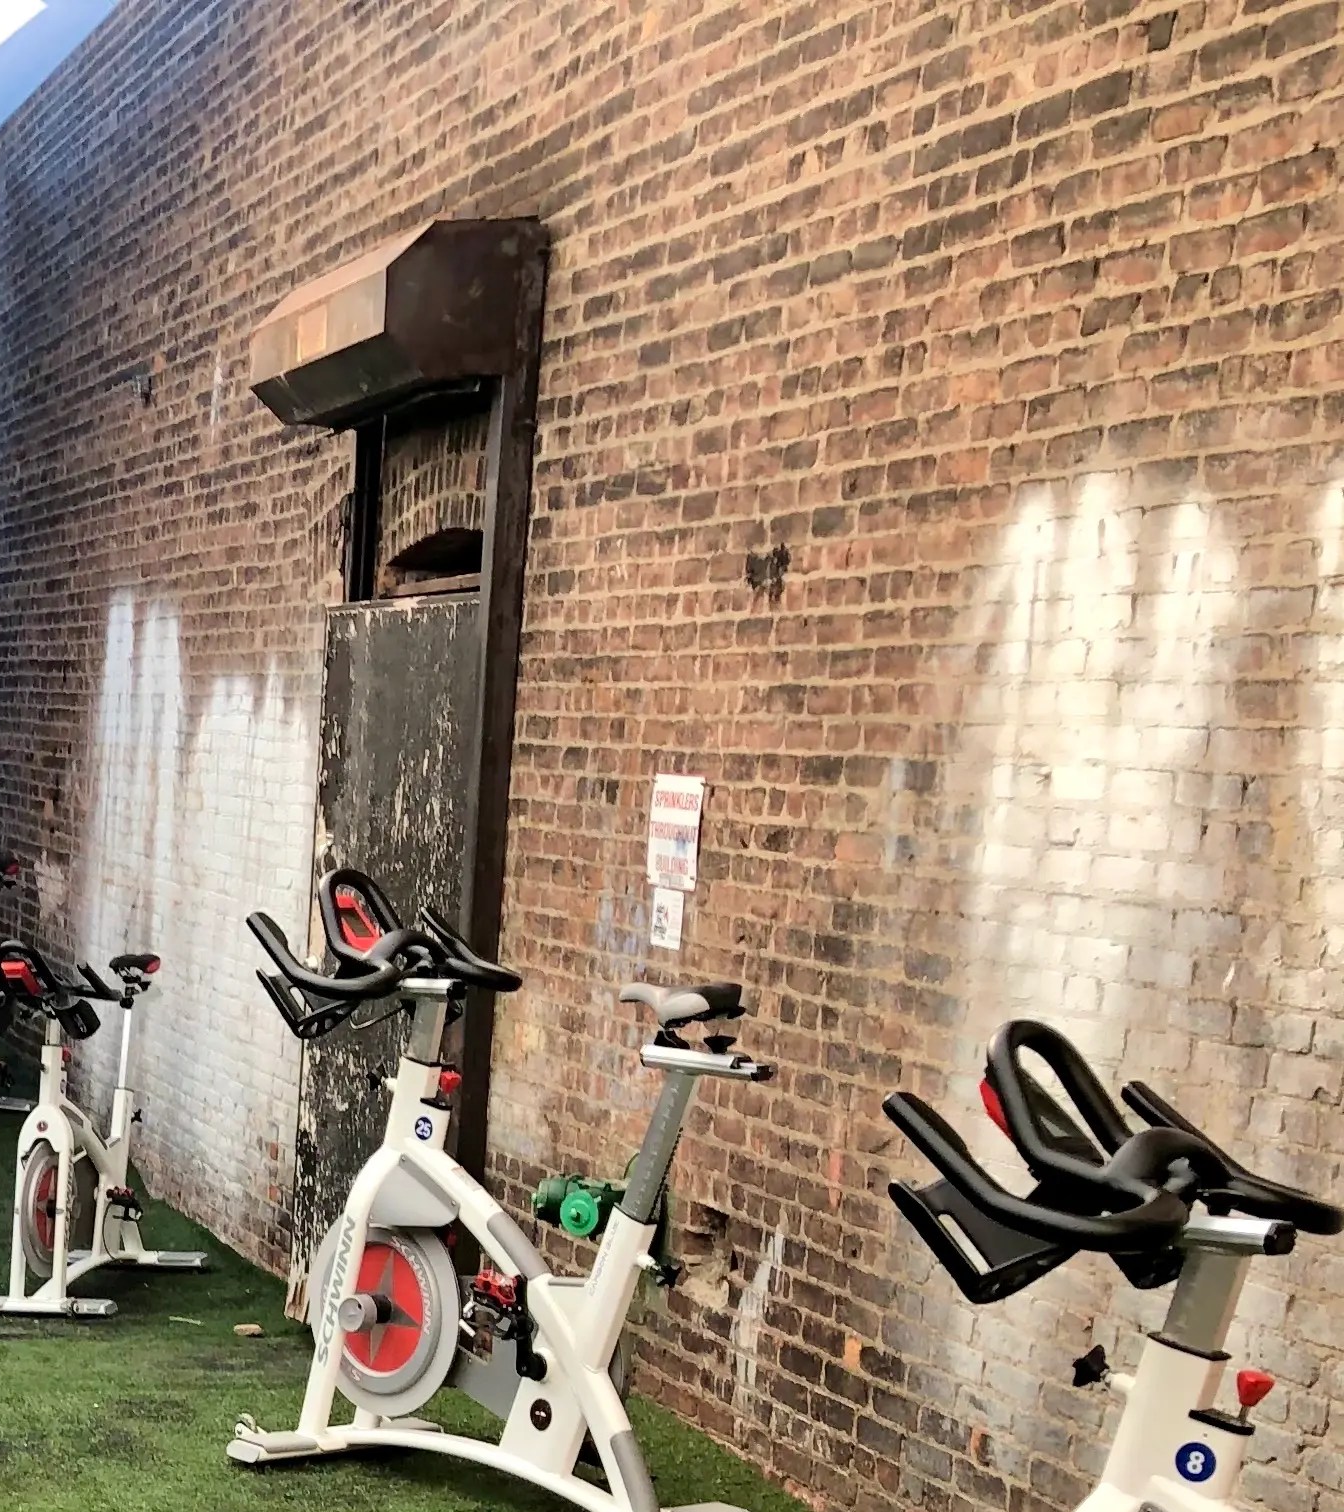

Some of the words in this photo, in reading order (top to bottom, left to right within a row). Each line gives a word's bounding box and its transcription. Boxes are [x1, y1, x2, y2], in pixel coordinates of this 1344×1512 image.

[654, 790, 699, 812] SPRINKLERS
[655, 853, 689, 875] BUILDING
[415, 1119, 431, 1138] 25
[318, 1215, 356, 1368] SCHWINN
[390, 1235, 432, 1335] SCHWINN
[1186, 1450, 1205, 1475] 8
